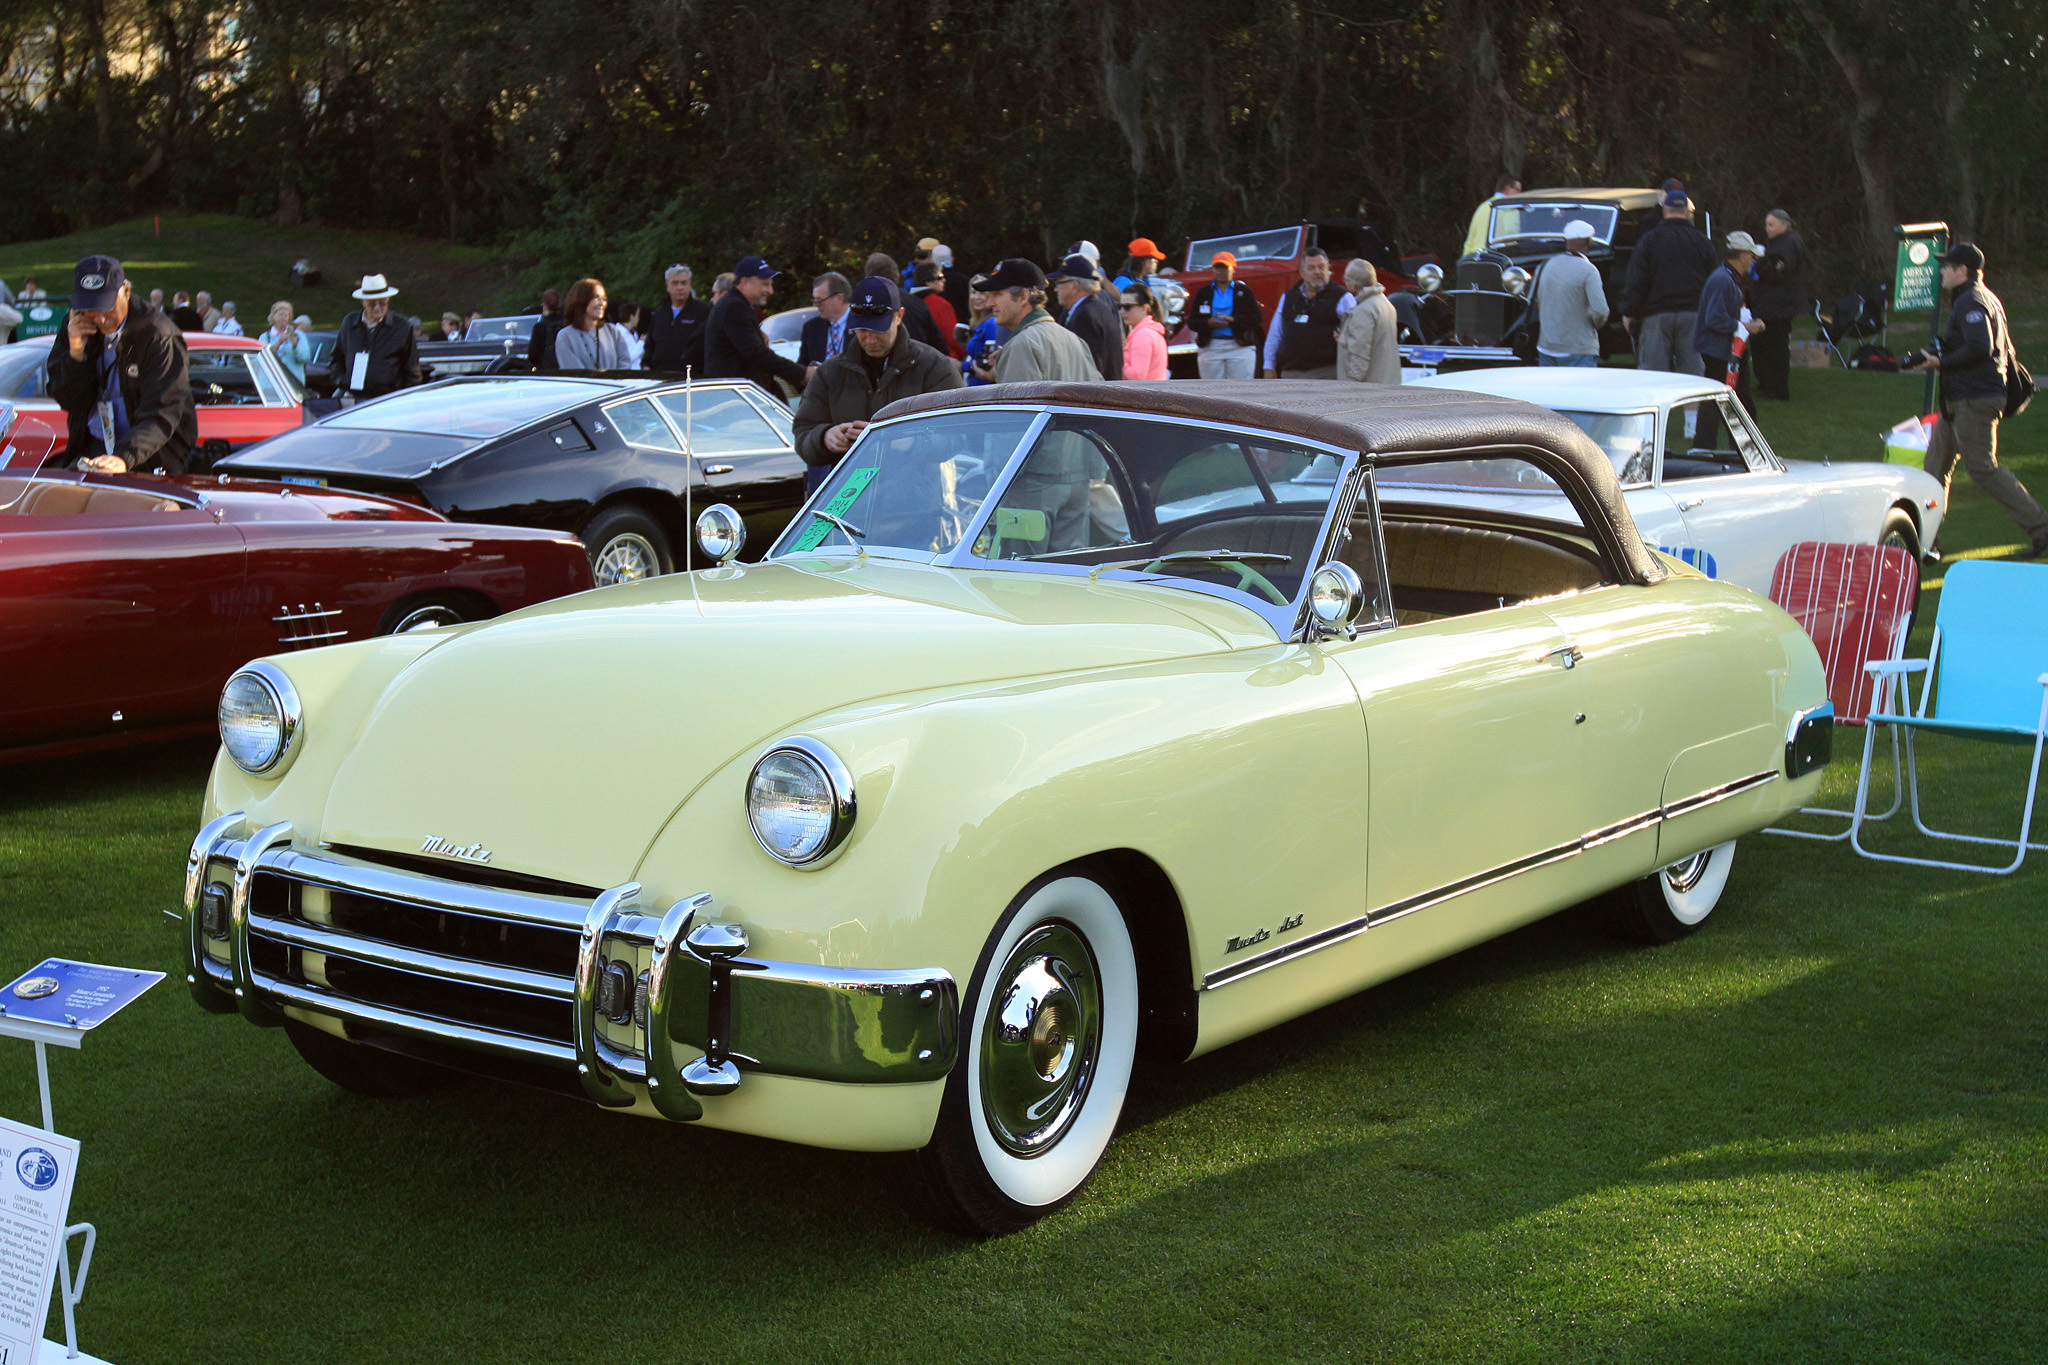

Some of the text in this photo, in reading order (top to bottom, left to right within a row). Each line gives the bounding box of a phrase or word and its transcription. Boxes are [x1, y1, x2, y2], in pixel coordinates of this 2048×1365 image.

[1902, 265, 1934, 277] AMERICAN
[25, 324, 57, 334] BENTLEY
[419, 834, 492, 863] Muntz
[1224, 912, 1304, 954] Muntz Jet
[14, 1194, 43, 1209] CONVERTIBLE
